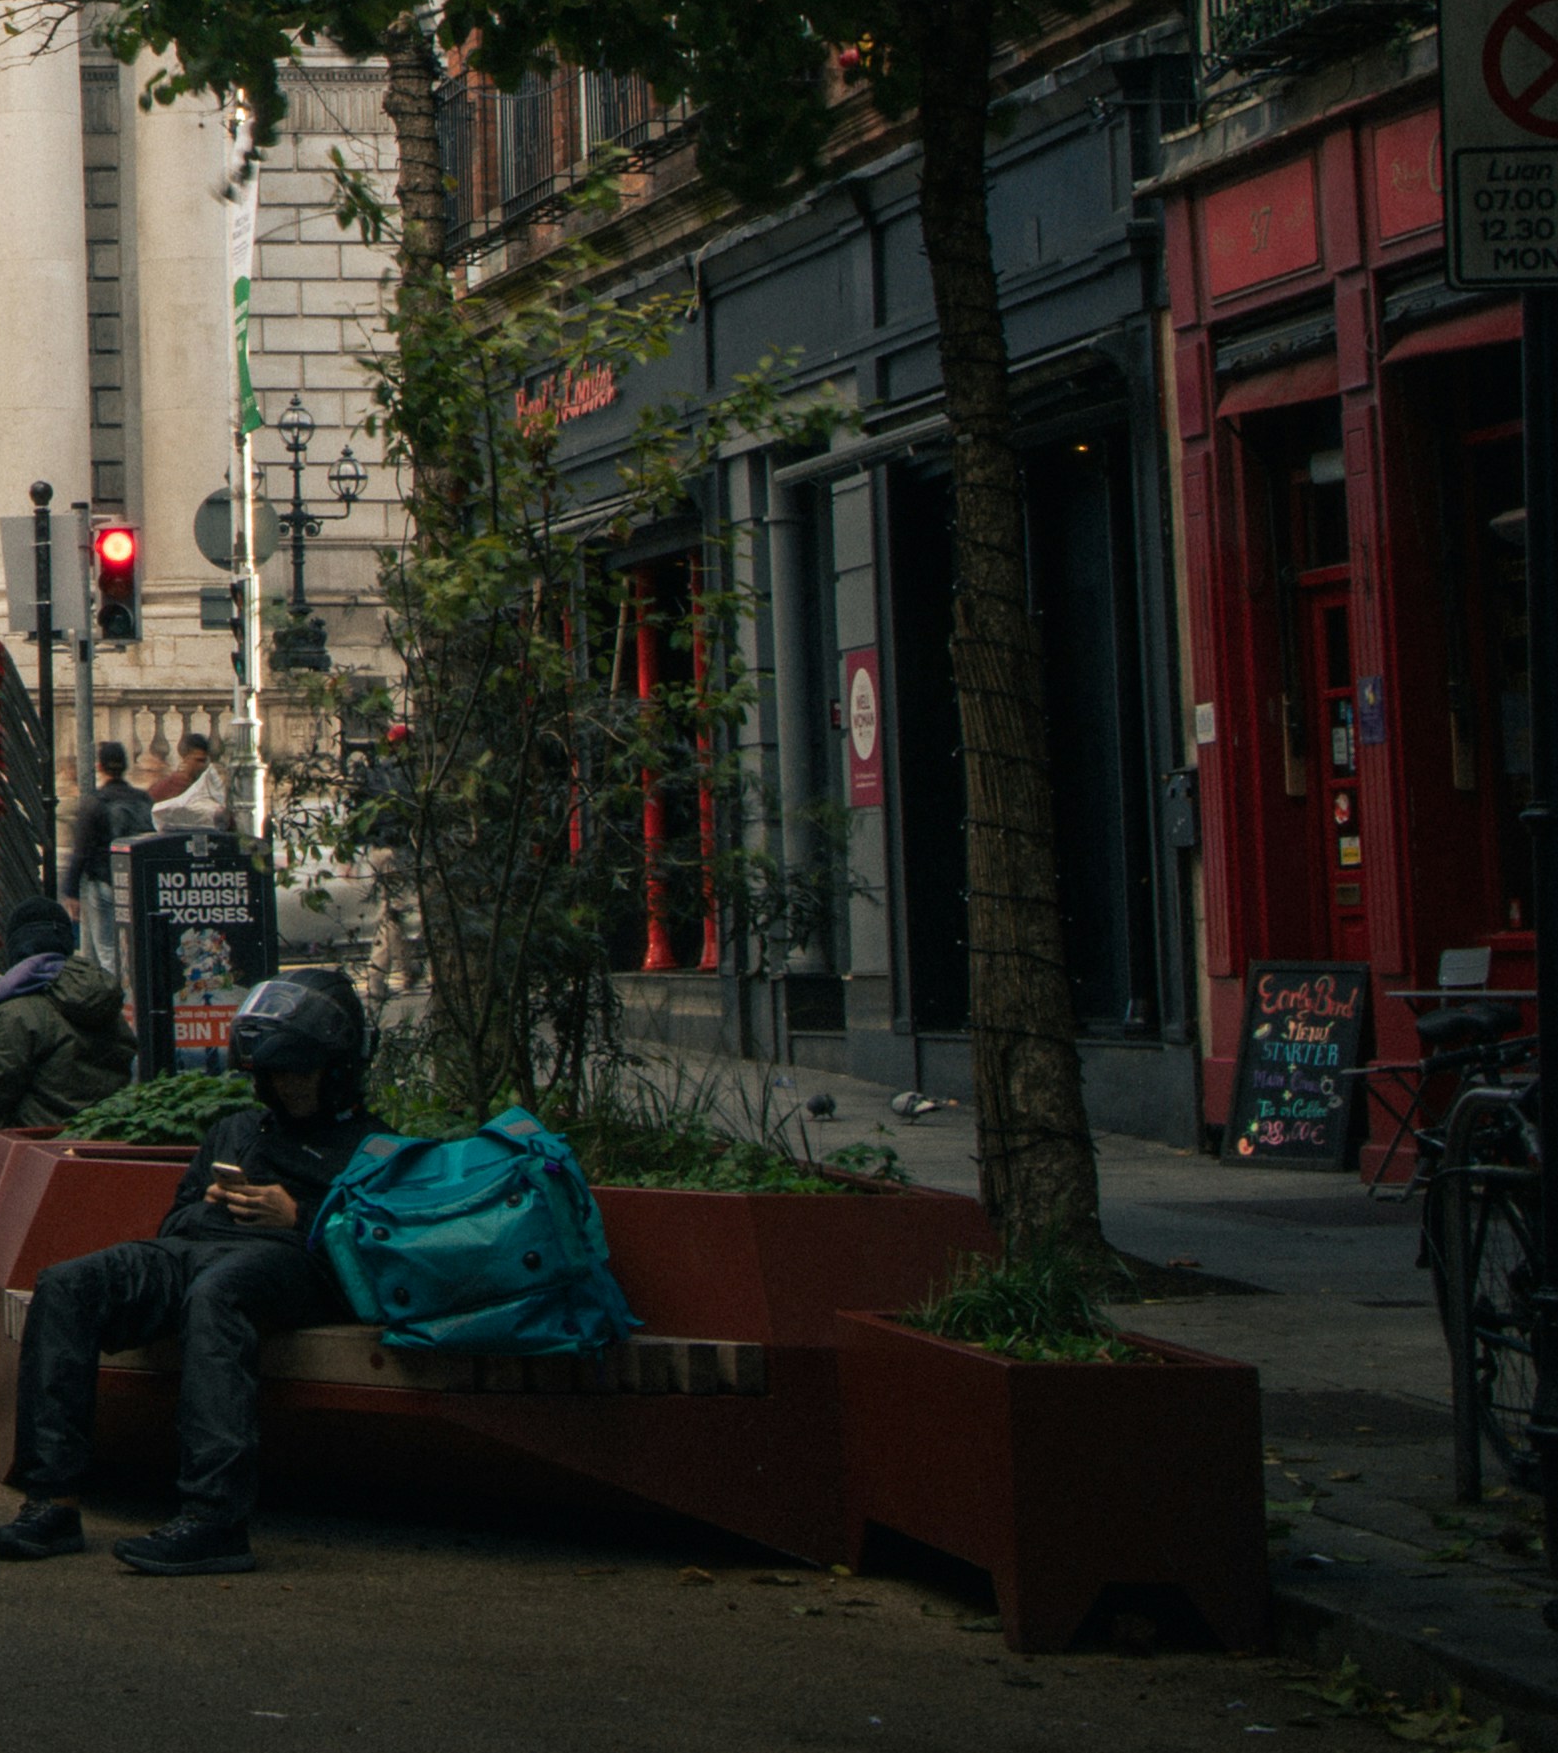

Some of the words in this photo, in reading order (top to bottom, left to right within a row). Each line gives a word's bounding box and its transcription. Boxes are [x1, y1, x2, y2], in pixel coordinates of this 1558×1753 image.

[1487, 159, 1552, 181] Luan
[1474, 188, 1556, 211] 07.00
[1479, 217, 1555, 241] 12.30
[1493, 248, 1558, 270] MON
[158, 873, 185, 888] NO
[191, 871, 248, 888] MORE
[158, 889, 249, 906] RUBBISH
[1313, 974, 1358, 1017] Bird
[174, 1021, 212, 1040] BIN
[1261, 1041, 1338, 1065] STARTER
